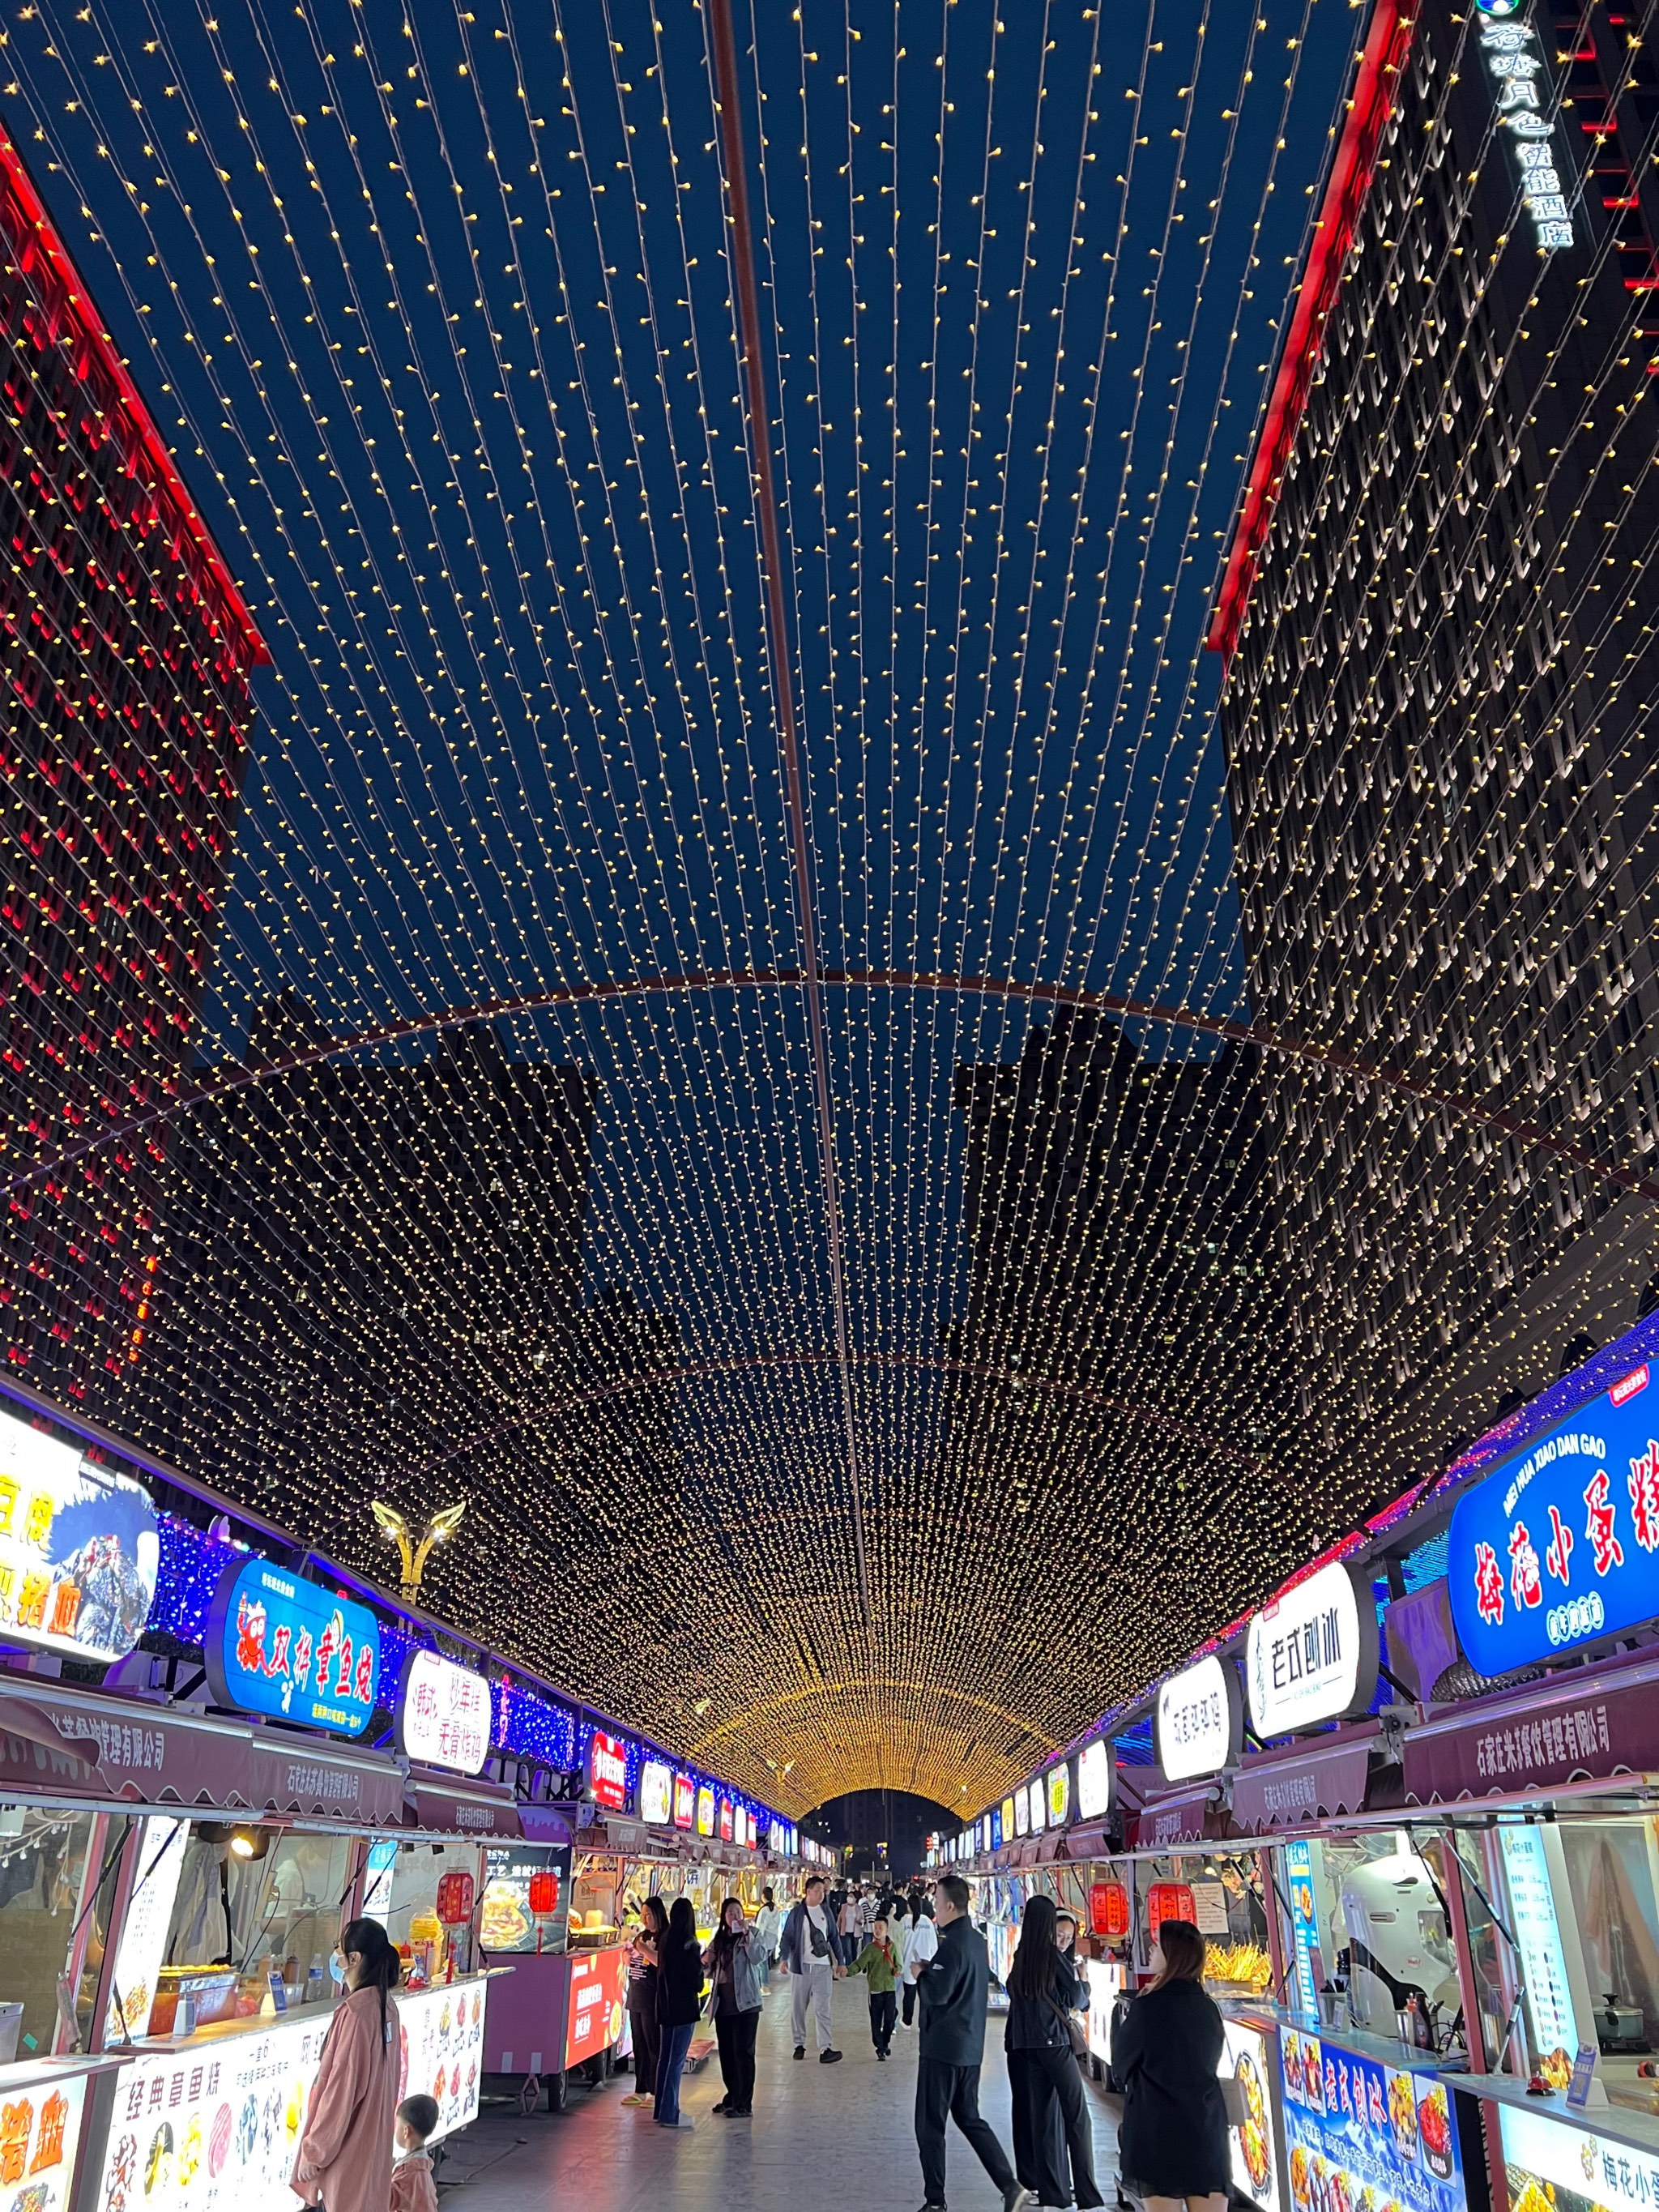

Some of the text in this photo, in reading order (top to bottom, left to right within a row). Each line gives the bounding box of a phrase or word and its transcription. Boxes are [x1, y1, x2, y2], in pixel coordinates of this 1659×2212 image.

[1480, 23, 1574, 247] 荷塘月色智能酒店
[1503, 1434, 1606, 1517] MEI HUA XIAO DAN GAO
[269, 1625, 373, 1704] 双拼章鱼烧
[1272, 1607, 1341, 1689] 老式刨冰
[437, 1718, 481, 1765] 无骨炸鸡
[1477, 1706, 1610, 1777] 石家庄米苏餐饮管理有限公司
[126, 2061, 222, 2121] 经典章鱼烧
